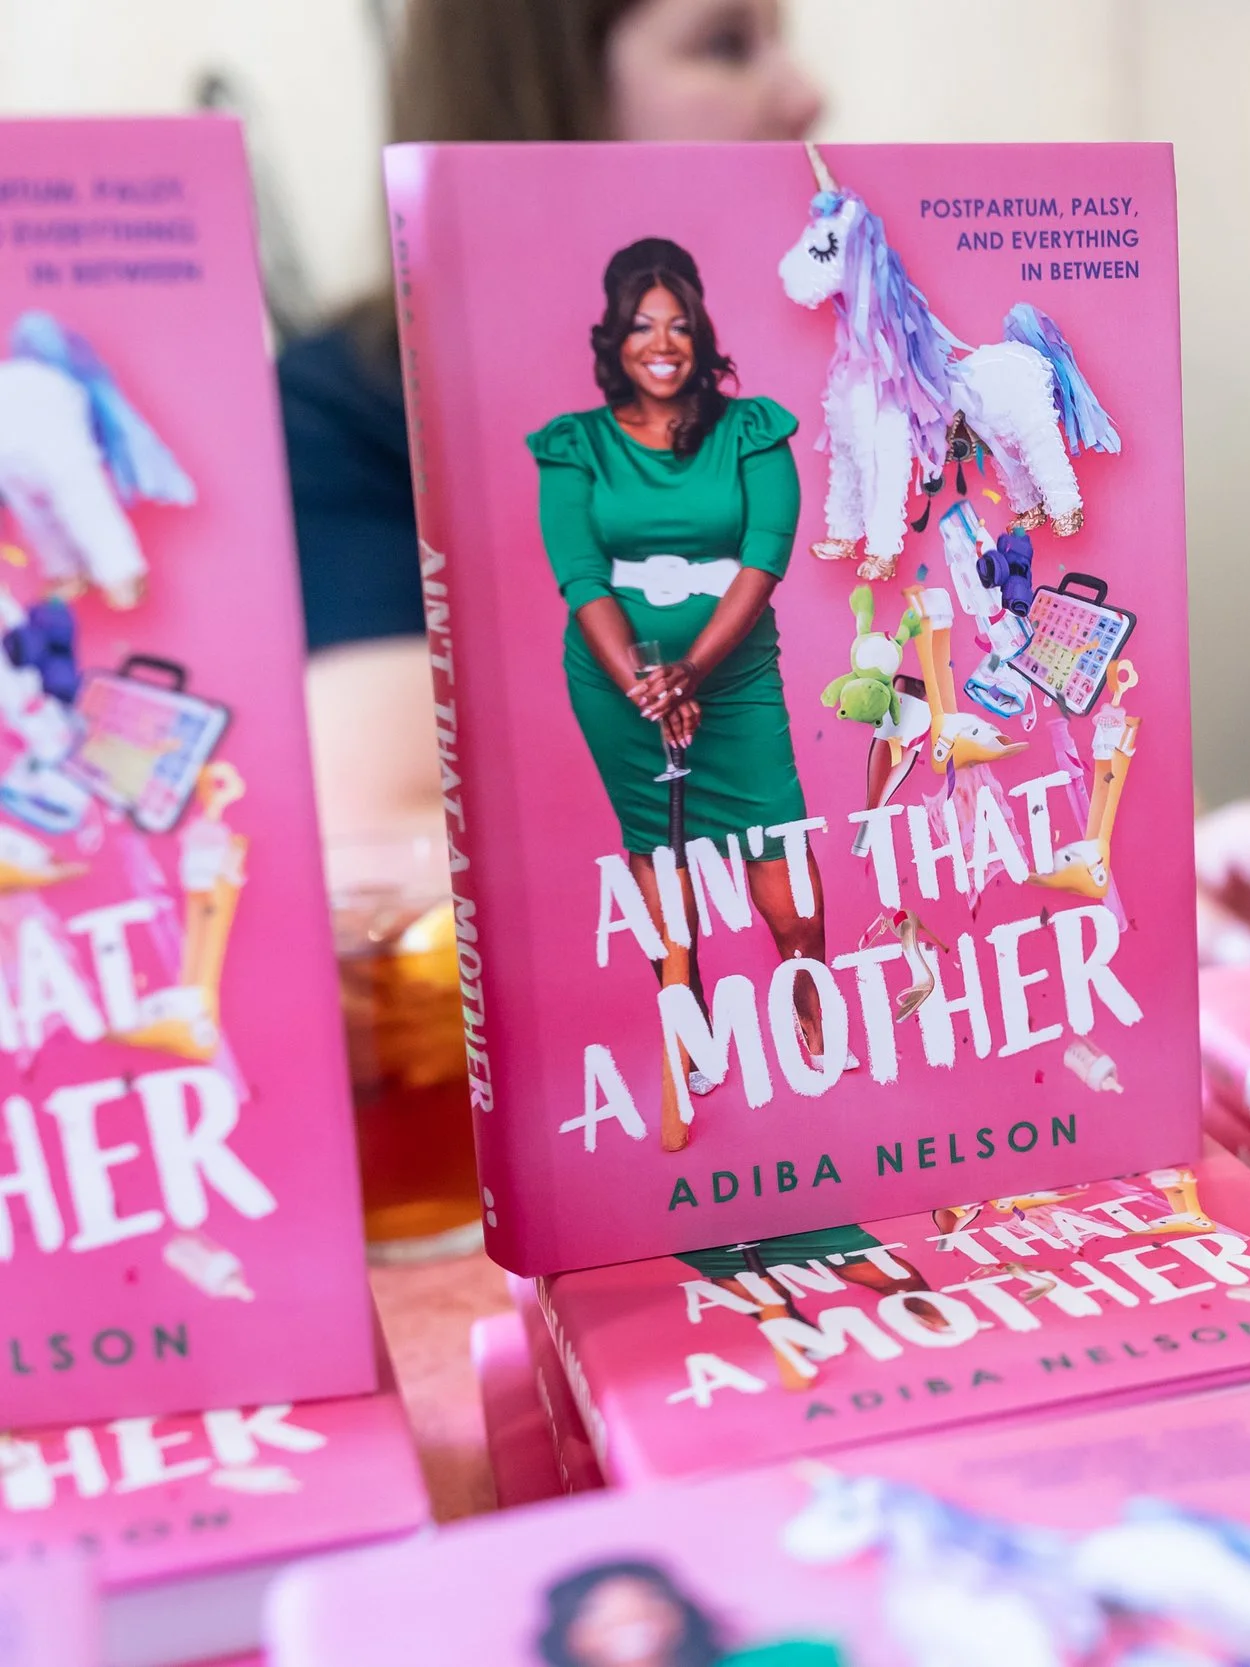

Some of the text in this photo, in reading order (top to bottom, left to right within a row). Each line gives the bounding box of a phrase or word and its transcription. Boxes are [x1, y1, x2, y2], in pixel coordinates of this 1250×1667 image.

[920, 197, 1139, 219] POSTPARTUM, PALSY,
[957, 229, 1139, 251] AND EVERYTHING
[1021, 260, 1139, 281] IN BETWEEN
[419, 538, 455, 686] AIN'T
[434, 698, 466, 833] THAT
[595, 771, 1072, 967] AIN'T THAT
[452, 891, 494, 1114] MOTHER
[559, 1043, 647, 1153] A
[657, 904, 1143, 1126] MOTHER
[668, 1114, 1078, 1211] ADIBA NELSON
[677, 1242, 911, 1324] AIN'T
[926, 1194, 1156, 1267] THAT
[9, 1323, 190, 1376] LSON
[667, 1353, 767, 1409] A
[804, 1368, 1003, 1421] ADIBA
